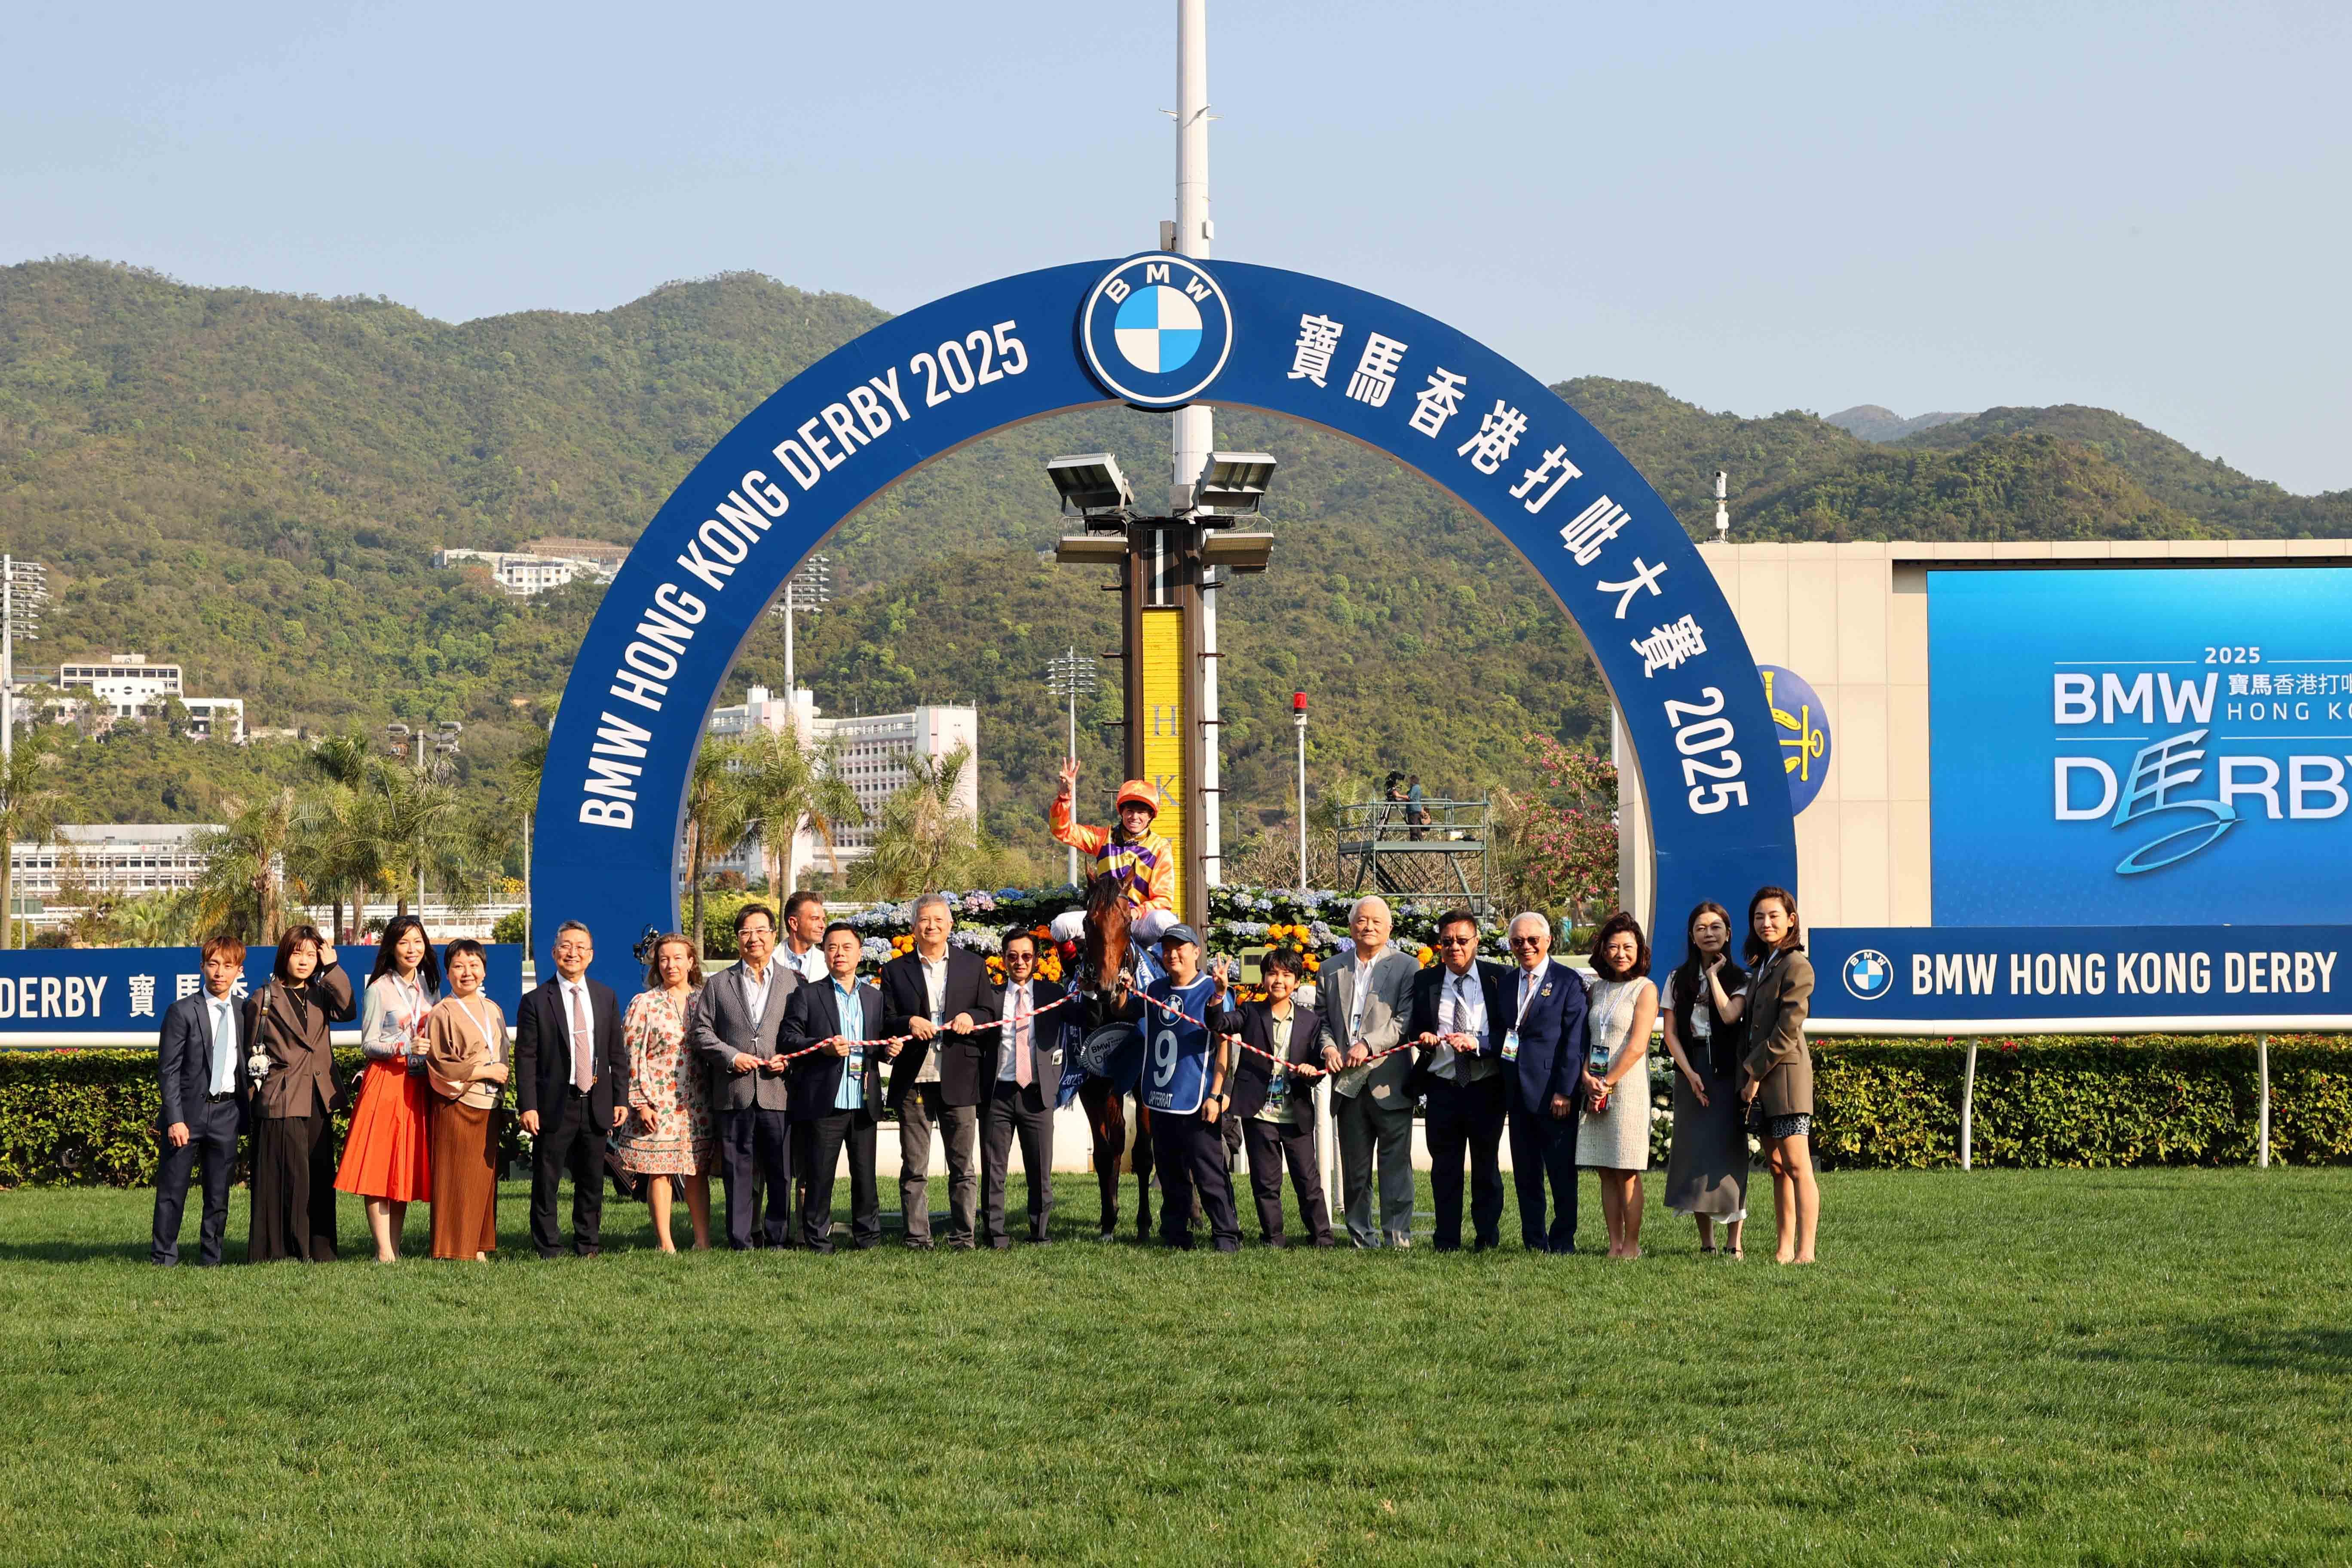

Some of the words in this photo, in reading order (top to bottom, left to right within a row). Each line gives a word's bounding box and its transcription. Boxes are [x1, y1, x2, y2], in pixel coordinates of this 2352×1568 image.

[1105, 264, 1212, 303] BMW
[910, 320, 1027, 407] 2025
[773, 367, 910, 490] DERBY
[677, 471, 789, 591] KONG
[1287, 314, 1707, 677] 寶馬香港打吡大賽
[1664, 687, 1748, 814] 2025
[610, 583, 706, 711] HONG
[2205, 647, 2260, 663] 2025
[2055, 673, 2218, 723] BMW
[2228, 703, 2308, 720] HONG
[2329, 703, 2352, 719] K
[579, 712, 651, 829] BMW
[1850, 952, 1886, 966] BMW
[1913, 954, 1997, 995] BMW
[2011, 954, 2105, 995] HONG
[2118, 952, 2210, 994] KONG
[2225, 952, 2337, 993] DERBY
[0, 976, 107, 1018] DERBY
[1091, 1041, 1111, 1054] BMW
[1153, 1029, 1178, 1087] 9
[1062, 1073, 1084, 1085] 2025
[1155, 1091, 1173, 1108] FERRAT
